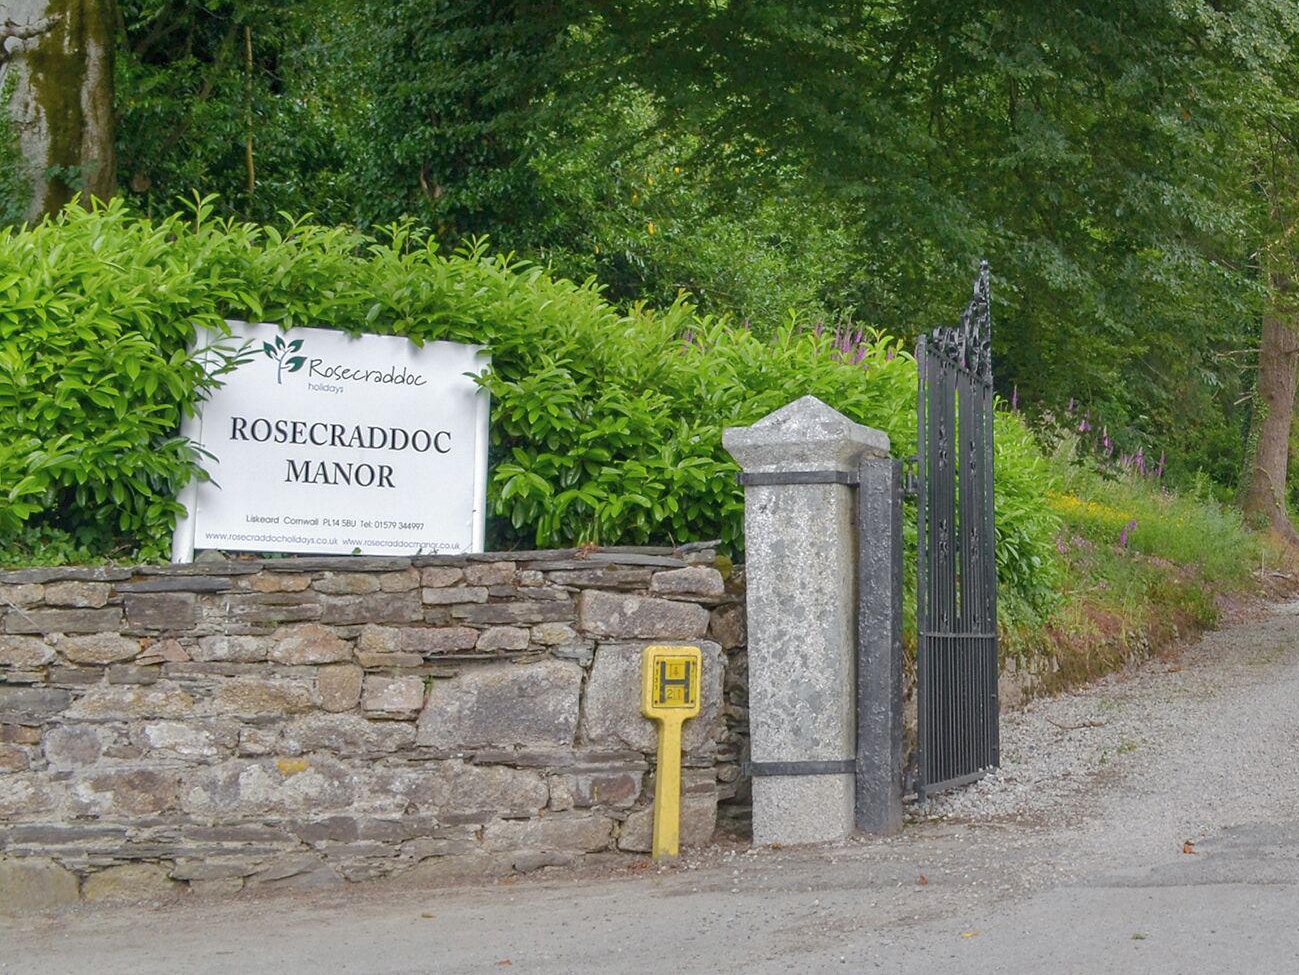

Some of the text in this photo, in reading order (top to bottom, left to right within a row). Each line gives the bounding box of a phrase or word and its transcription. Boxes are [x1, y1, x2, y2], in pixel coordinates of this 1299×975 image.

[309, 358, 427, 387] Rosecraddoc
[308, 382, 344, 394] holidays
[229, 416, 452, 454] ROSECRADDOC
[284, 459, 396, 489] MANOR
[246, 514, 279, 524] Liskeard
[283, 516, 319, 526] Cornwall
[323, 518, 340, 527] PL14
[360, 520, 373, 528] Tel:
[375, 521, 397, 529] 01579
[398, 522, 425, 531] 344997
[205, 532, 460, 550] www.rosecraddocholidays.co.uk www.rosecraddocmanor.co.uk
[660, 661, 690, 703] H
